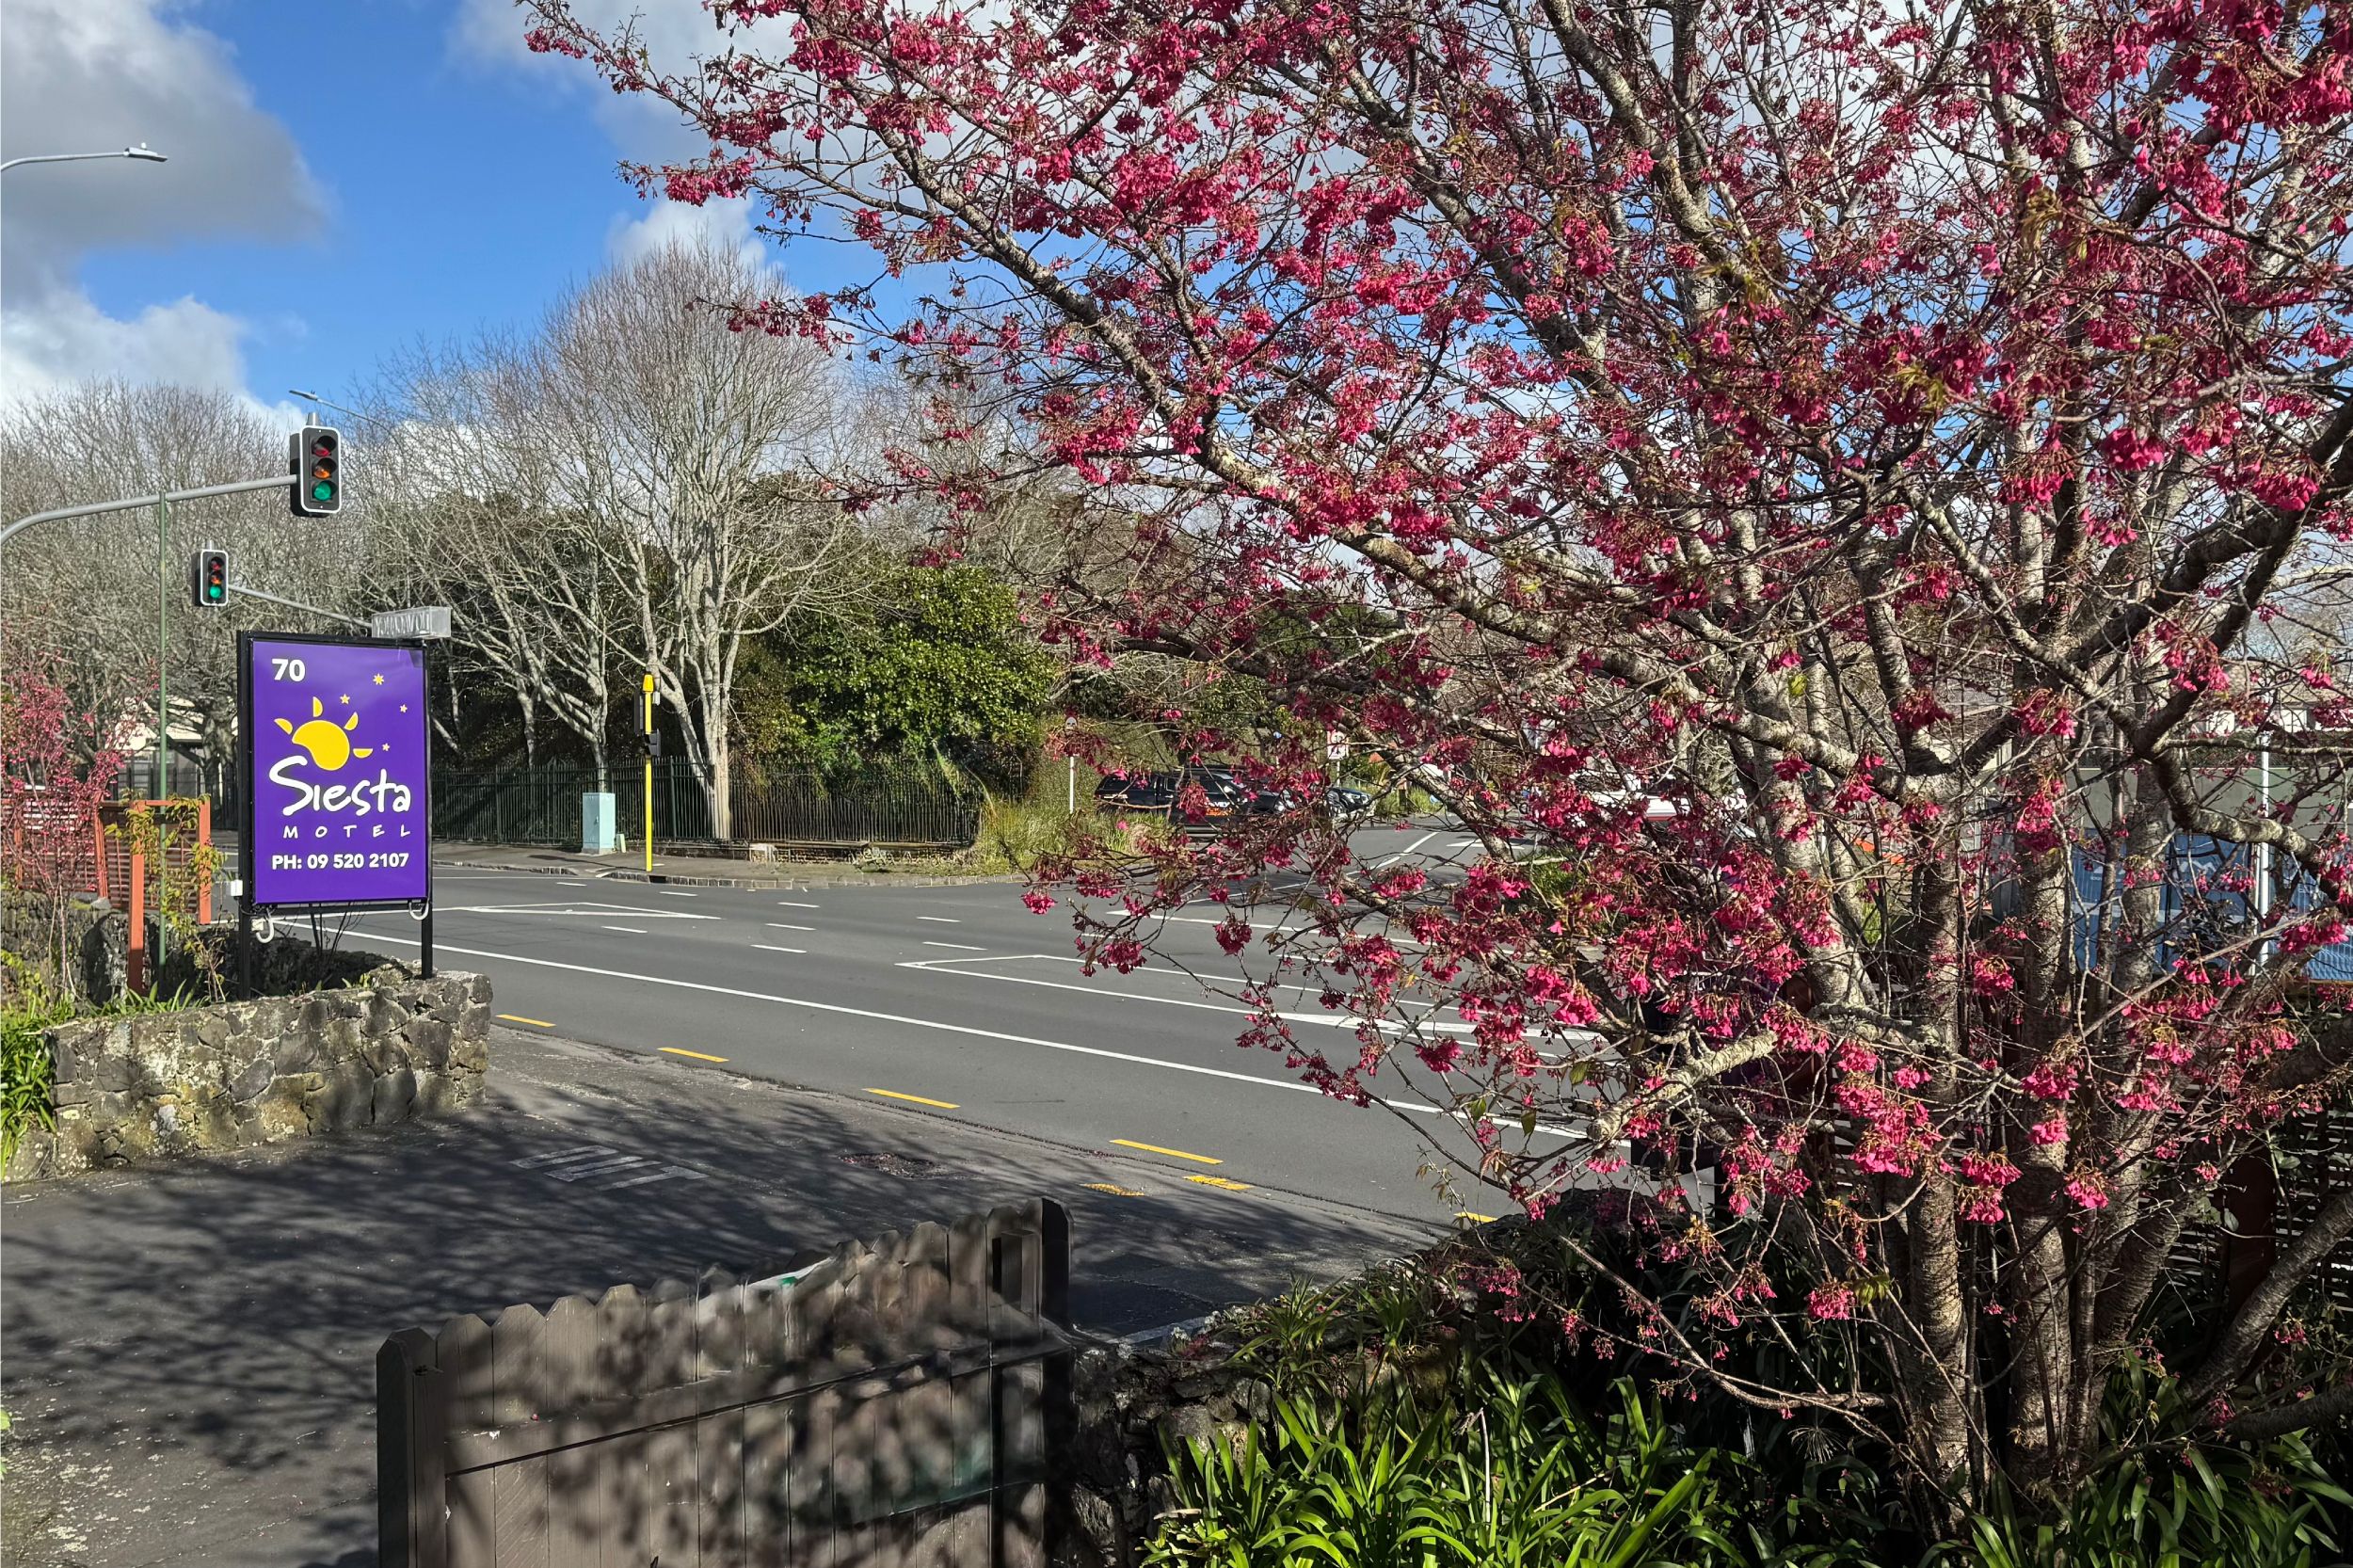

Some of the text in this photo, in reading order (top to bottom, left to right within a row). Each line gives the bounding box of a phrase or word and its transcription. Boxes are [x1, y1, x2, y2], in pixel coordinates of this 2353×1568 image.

[272, 659, 305, 681] 70
[269, 756, 410, 815] Siesta
[283, 824, 410, 839] MOTEL
[272, 853, 408, 870] PH: 09 520 2107
[508, 1145, 710, 1191] OUT
